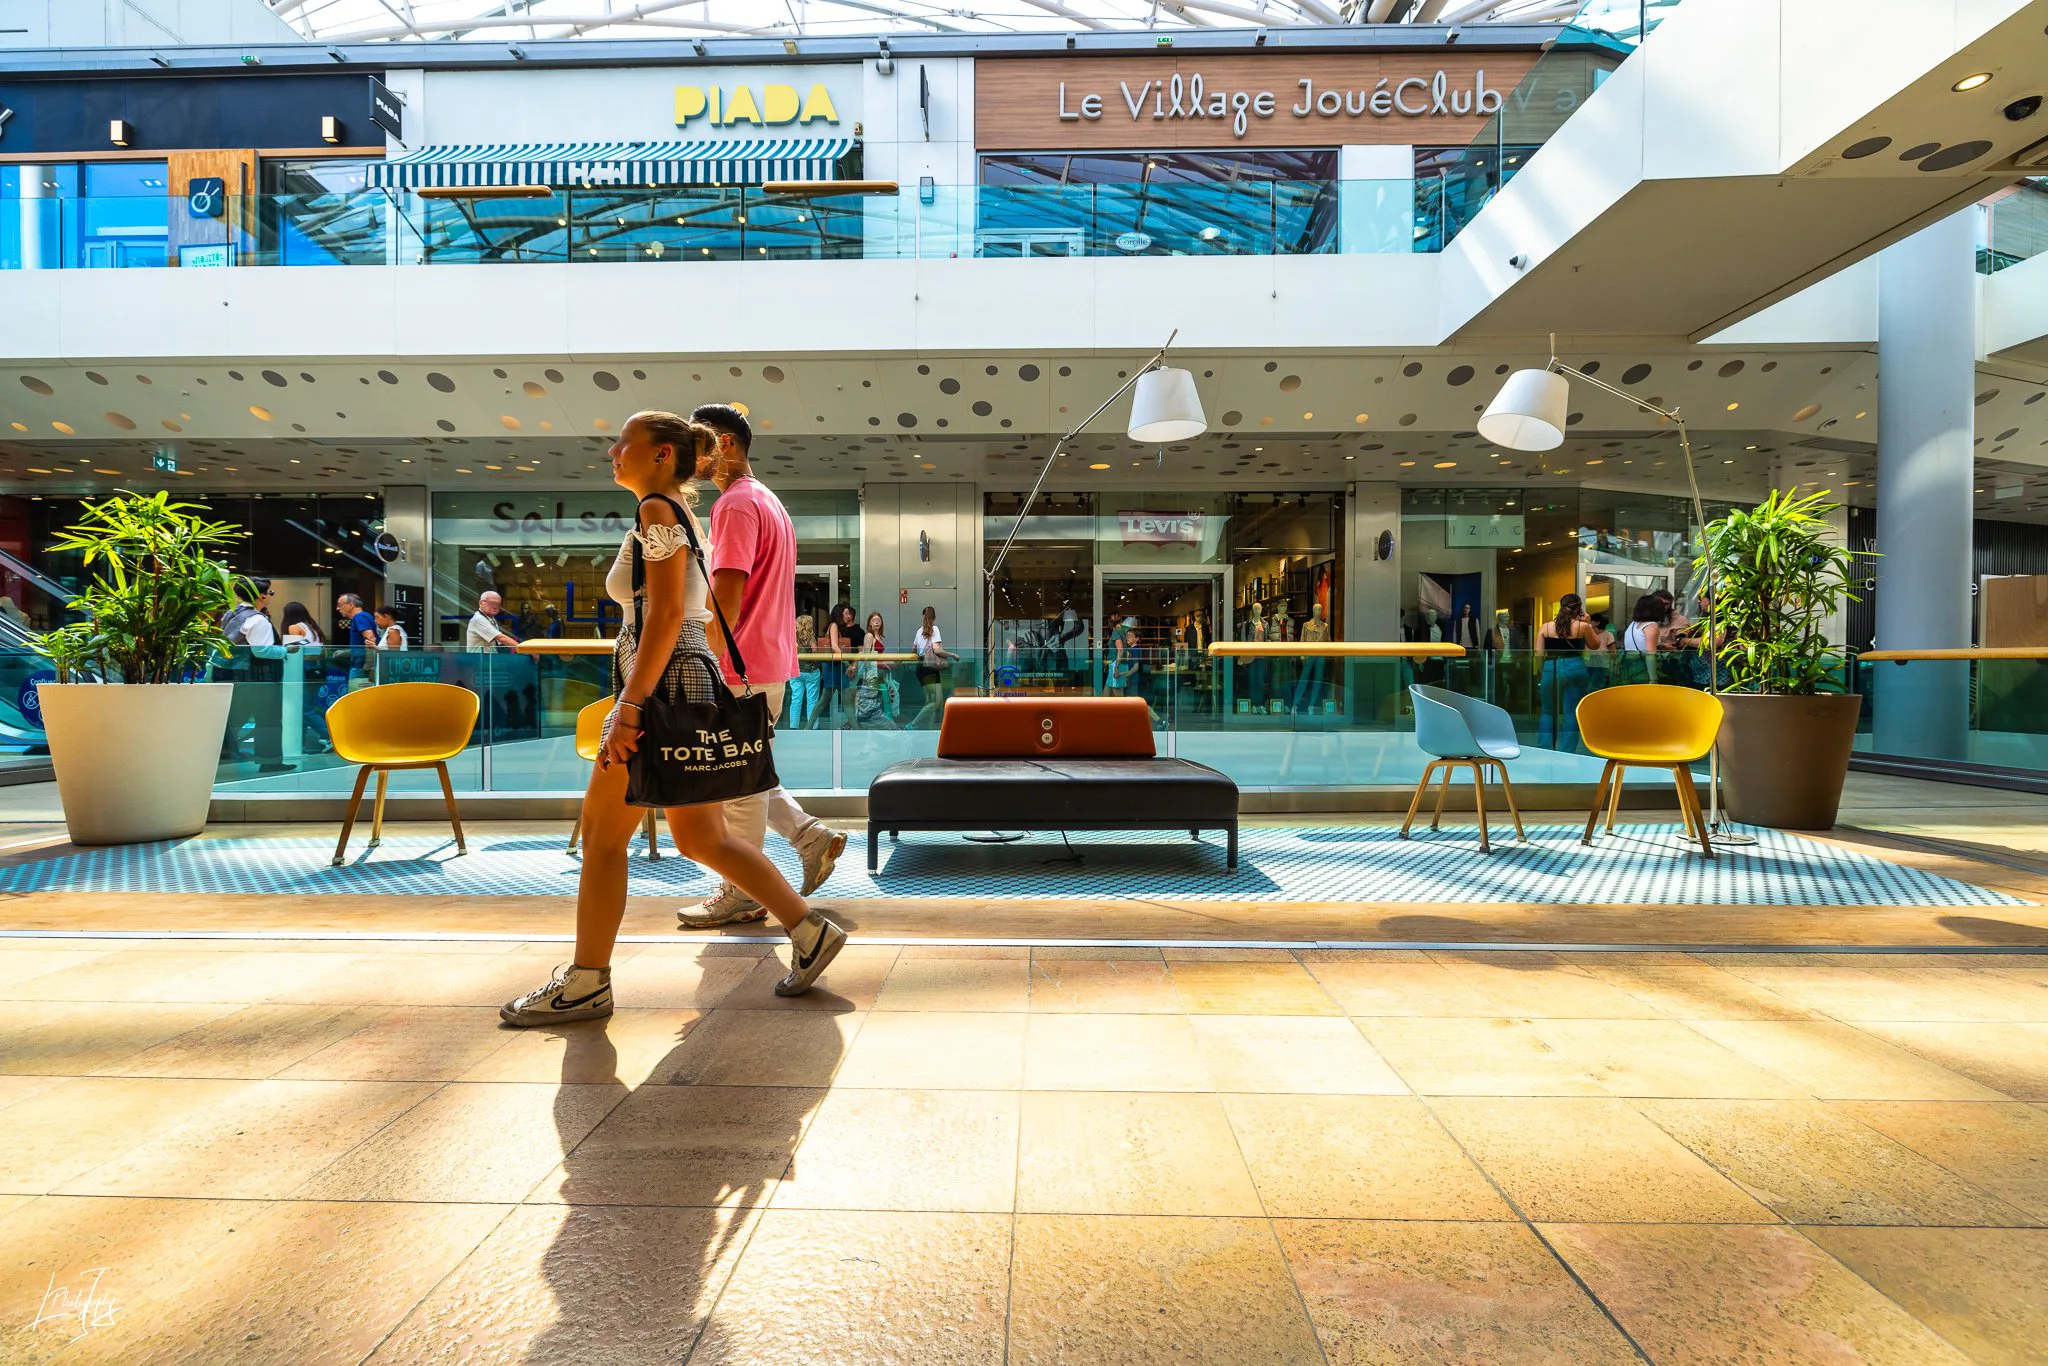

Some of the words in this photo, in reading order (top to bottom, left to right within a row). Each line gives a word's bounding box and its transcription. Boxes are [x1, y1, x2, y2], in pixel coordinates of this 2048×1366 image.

[375, 96, 400, 123] PIADA
[675, 83, 840, 128] PIADA
[1059, 81, 1103, 121] Le
[1120, 72, 1276, 138] Village
[1292, 69, 1503, 118] JouéClub
[490, 501, 635, 534] Salsa
[1127, 519, 1195, 535] Levi's
[696, 729, 732, 744] THE
[660, 747, 716, 761] TOTE
[723, 740, 763, 758] BAG
[712, 759, 748, 771] JACOBS
